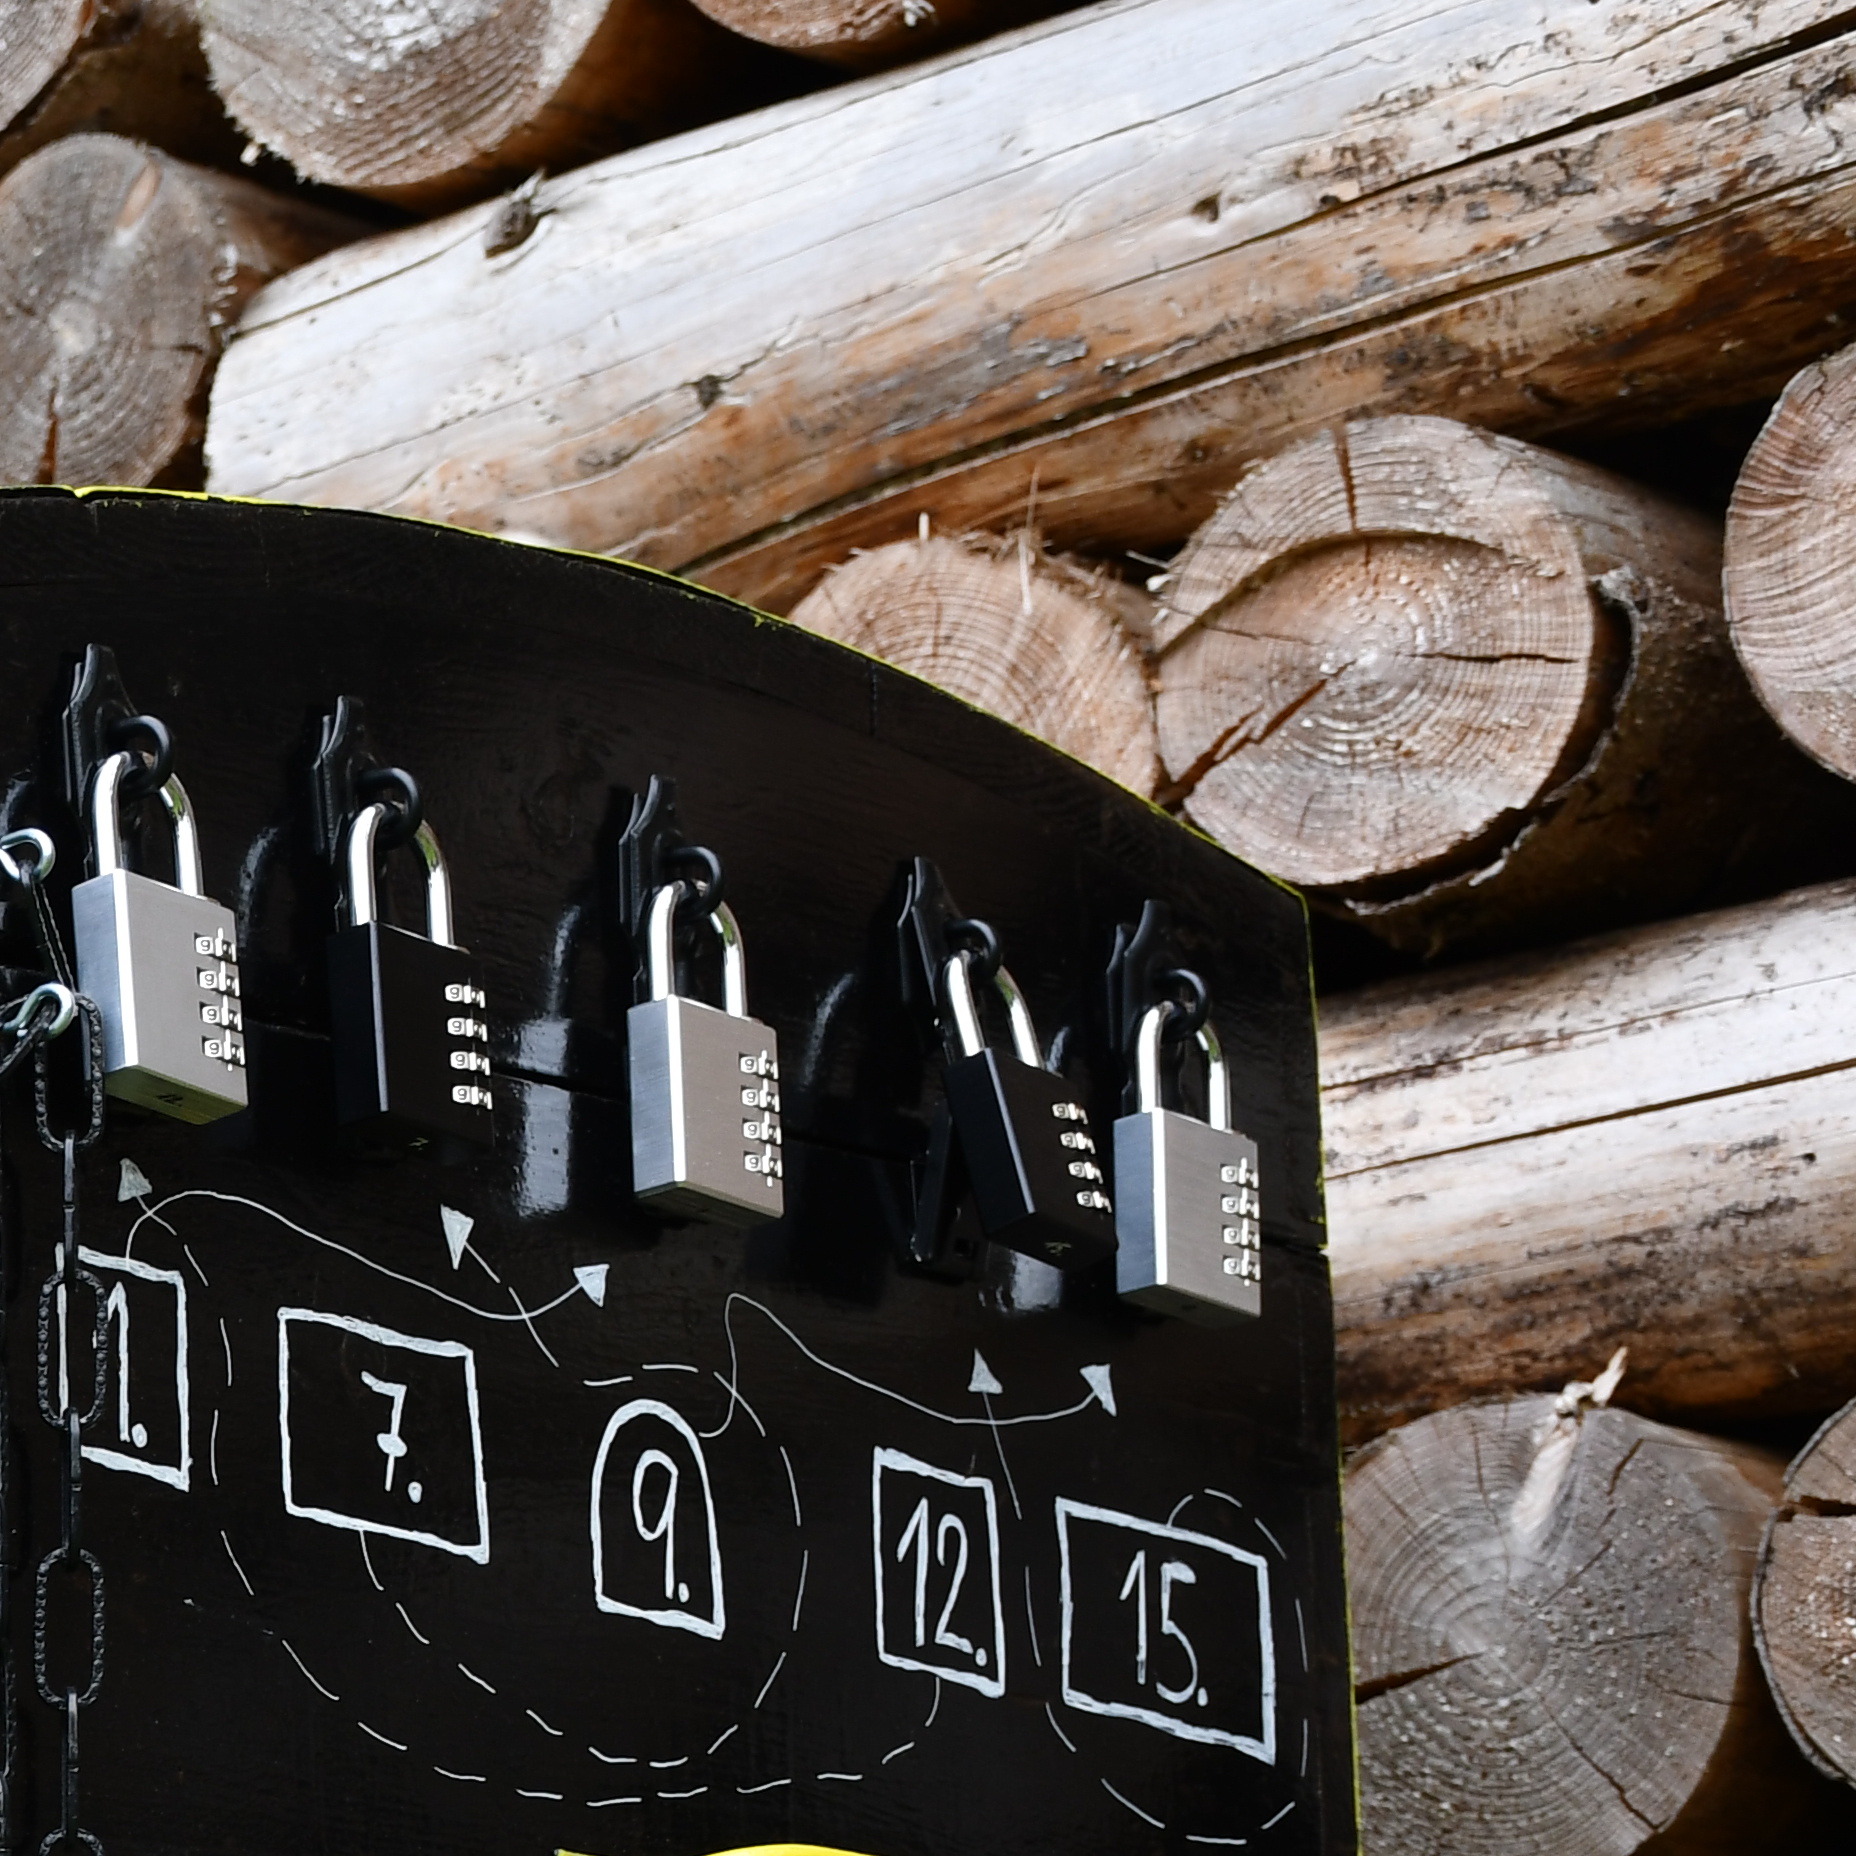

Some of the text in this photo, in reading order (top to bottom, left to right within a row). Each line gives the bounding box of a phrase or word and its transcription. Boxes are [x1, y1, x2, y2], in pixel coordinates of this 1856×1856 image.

[361, 1371, 423, 1503] 7.
[632, 1449, 690, 1603] 9.
[897, 1497, 987, 1667] 12.
[1120, 1550, 1208, 1706] 15.
